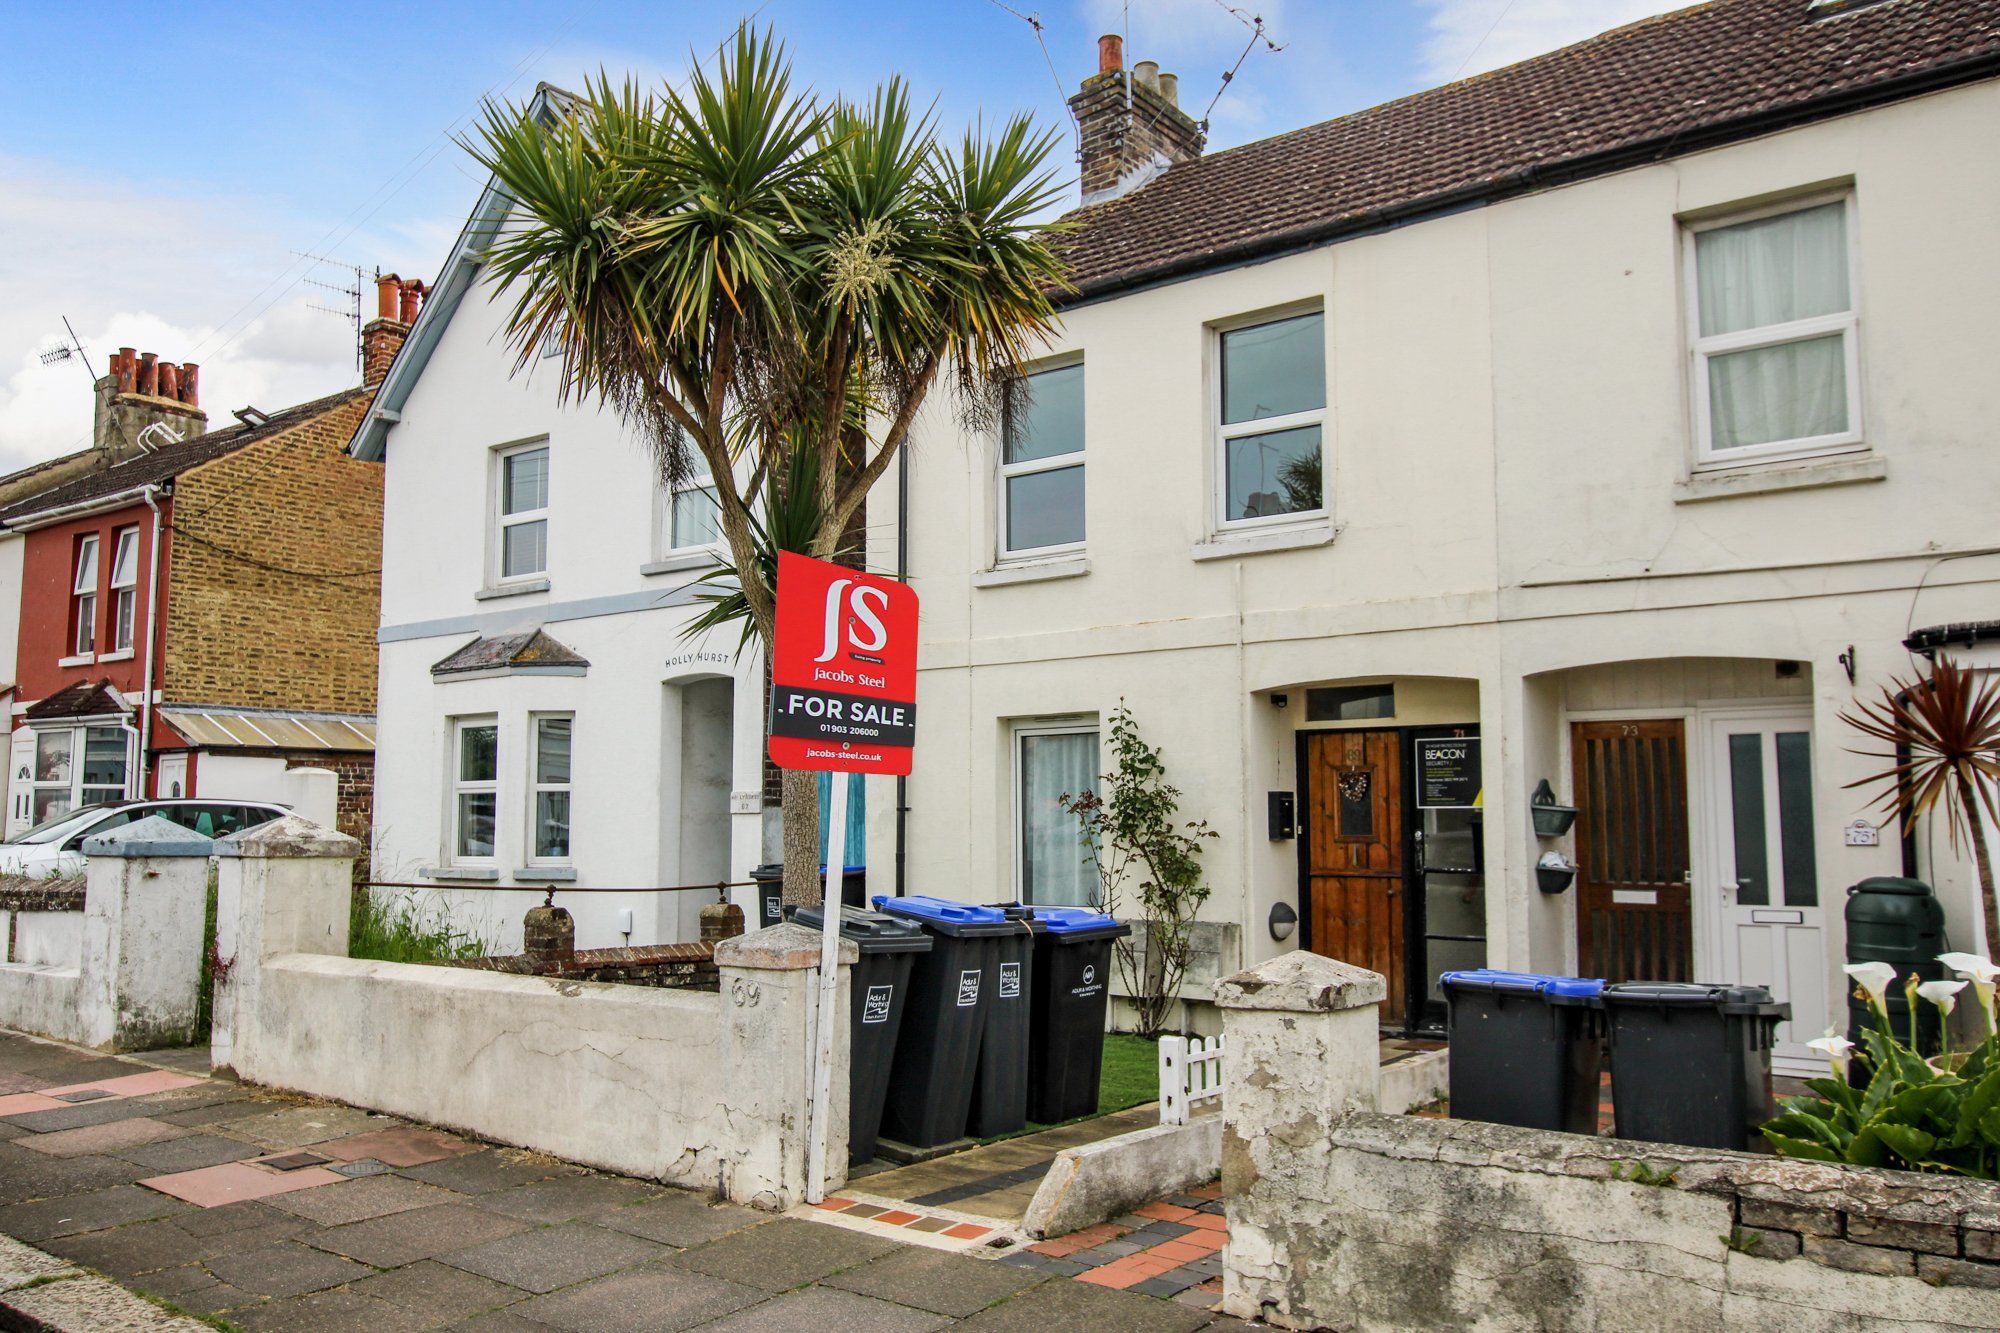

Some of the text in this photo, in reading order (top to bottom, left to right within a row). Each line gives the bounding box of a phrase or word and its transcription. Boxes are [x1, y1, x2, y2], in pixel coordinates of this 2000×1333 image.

[665, 652, 729, 669] HOLLY HURST
[814, 667, 886, 689] Jacobs Steel
[788, 694, 905, 727] FOR SALE
[820, 724, 879, 737] 01903 206000
[1621, 725, 1639, 737] 73
[806, 748, 882, 762] jacobs-steel.co.uk
[1425, 749, 1466, 760] BEACON
[731, 977, 760, 1008] 69
